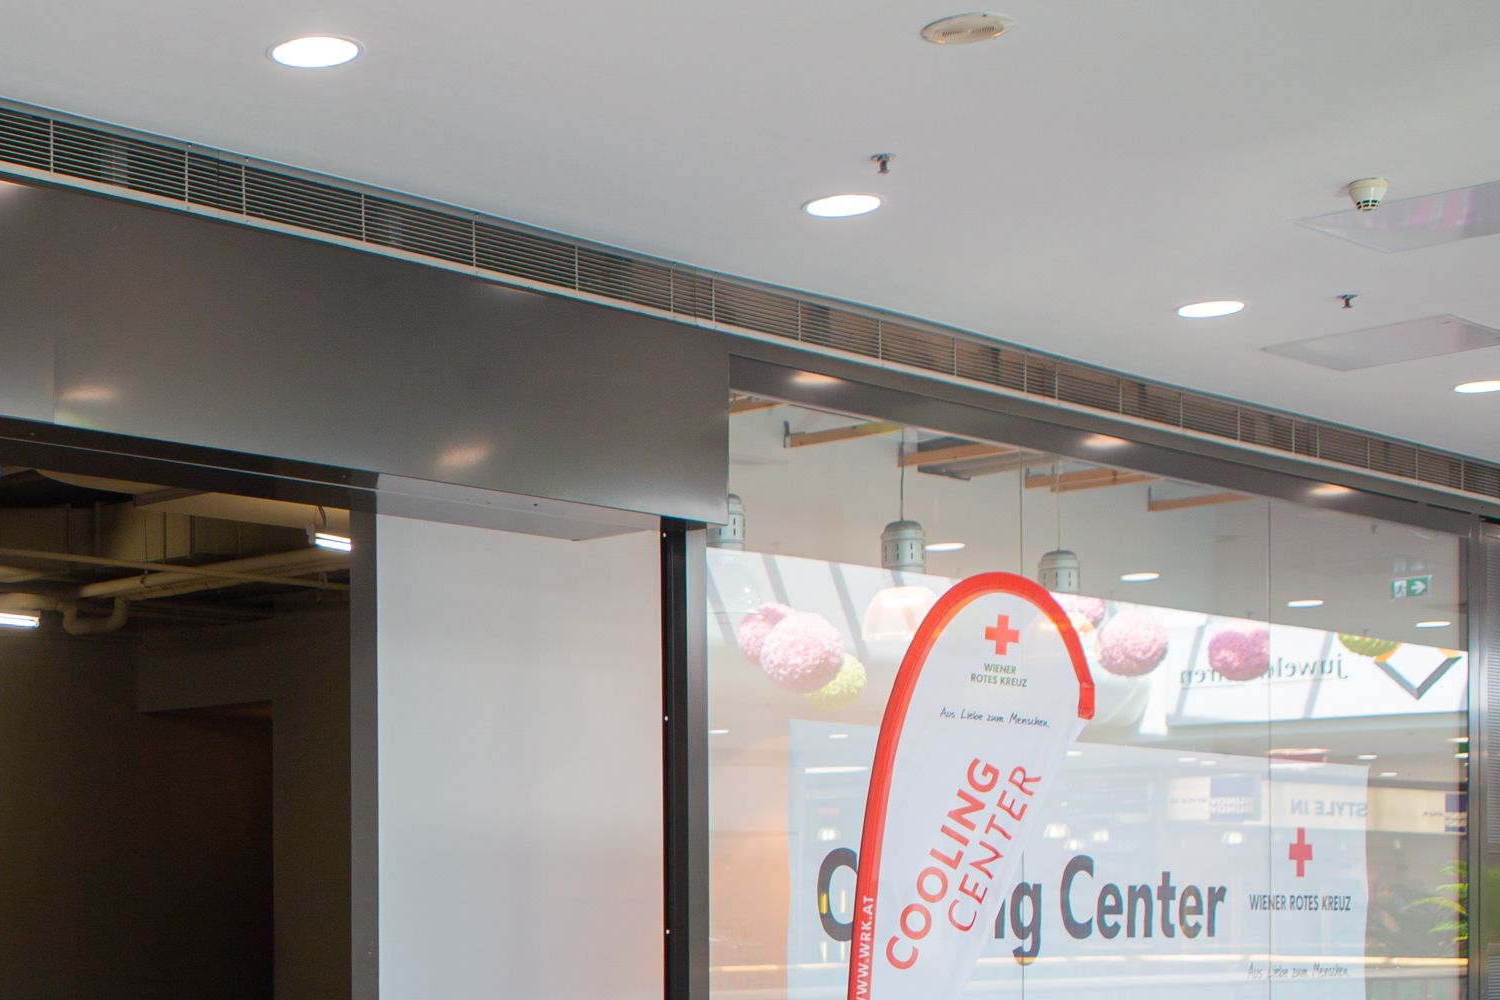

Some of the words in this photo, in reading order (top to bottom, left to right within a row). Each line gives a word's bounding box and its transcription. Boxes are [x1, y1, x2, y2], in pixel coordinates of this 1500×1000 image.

[984, 663, 1016, 674] WIENER
[970, 674, 997, 684] ROTES
[1000, 676, 1028, 687] KREUZ
[940, 706, 956, 718] Aus
[948, 765, 1042, 932] CENTER
[886, 758, 1000, 970] COOLING
[1060, 854, 1228, 940] Center
[1250, 894, 1286, 910] WIENER
[1290, 895, 1318, 910] ROTES
[1322, 896, 1351, 910] KREUZ
